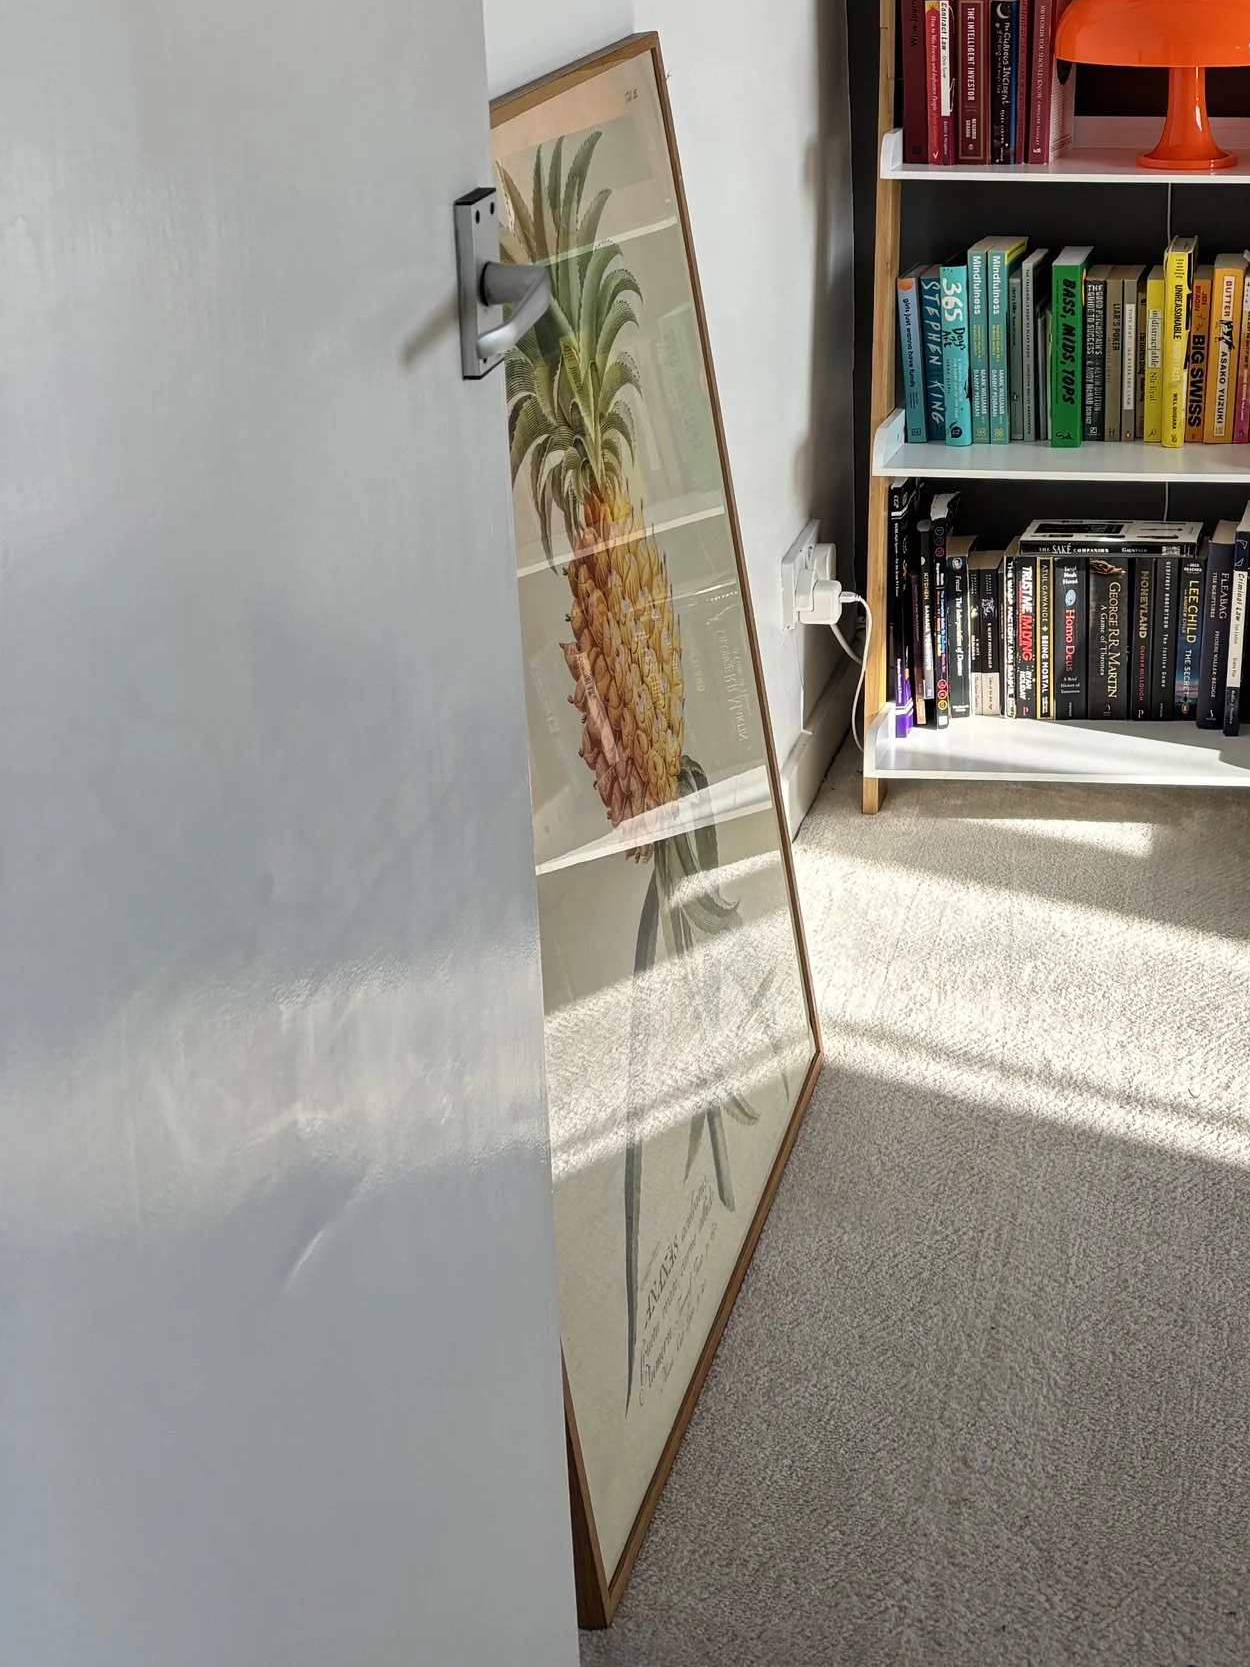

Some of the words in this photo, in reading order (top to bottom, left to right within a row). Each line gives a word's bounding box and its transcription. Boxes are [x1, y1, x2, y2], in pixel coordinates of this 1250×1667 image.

[967, 7, 975, 21] THE
[1038, 15, 1046, 36] WORDS
[910, 24, 918, 47] Wine
[967, 21, 975, 65] INTELLIGENT
[1037, 52, 1045, 79] SHOULD
[967, 67, 975, 101] INVESTOR
[941, 277, 963, 322] 365
[972, 255, 982, 315] Mindfulness
[991, 255, 1001, 315] Mindfulness
[1060, 277, 1077, 319] BASS,
[1095, 291, 1104, 309] GOOD
[1224, 280, 1233, 317] BUTTER
[902, 297, 911, 313] girls
[1086, 291, 1095, 313] GUIDE
[1112, 303, 1121, 326] LIAR'S
[1172, 284, 1183, 340] UNREASONABLE
[903, 313, 912, 327] just
[920, 281, 942, 365] STEPHEN
[1086, 313, 1095, 323] TO
[1094, 310, 1104, 355] PSYCHOPATH'S
[941, 330, 952, 348] Art
[952, 326, 966, 351] Days
[1060, 323, 1077, 365] MIDS,
[1086, 324, 1095, 355] SUCCESS
[1112, 326, 1121, 351] POKER
[1190, 334, 1205, 365] BIG
[906, 351, 915, 367] have
[1219, 351, 1228, 384] ASAKO
[1061, 368, 1077, 405] TOPS
[1149, 371, 1157, 384] Nir
[927, 380, 945, 424] KING
[1147, 385, 1157, 401] Eyal
[1187, 367, 1204, 428] SWISS
[1217, 388, 1226, 424] YUZUKI
[1051, 542, 1072, 555] SAKÉ
[923, 572, 931, 600] KITCHEN
[954, 575, 963, 592] Freud
[1006, 578, 1014, 605] WASP
[1021, 565, 1034, 592] TRUST
[1188, 580, 1200, 603] LEE
[1210, 571, 1218, 583] THE
[1236, 573, 1246, 606] Criminal
[955, 597, 964, 607] The
[1108, 581, 1121, 626] GEORGE
[1138, 570, 1150, 639] MONEYLAND
[1209, 584, 1217, 618] SCRIPTURES
[1218, 572, 1230, 620] FLEABAG
[955, 608, 963, 646] Interpretation
[1064, 608, 1076, 643] Homo
[1099, 612, 1107, 632] Game
[1185, 604, 1199, 644] CHILD
[1235, 607, 1243, 622] Law
[924, 633, 933, 671] YOSHIMOTO
[1021, 629, 1034, 661] LYING
[1041, 635, 1049, 659] BEING
[1099, 635, 1107, 643] of
[1212, 630, 1220, 652] PHOEBE
[955, 654, 964, 677] Dreams
[1064, 644, 1076, 672] Deus
[1099, 646, 1107, 676] Thrones
[1183, 649, 1192, 665] THE
[1006, 664, 1014, 695] BANKS
[1041, 662, 1049, 693] MORTAL
[1107, 651, 1120, 698] MARTIN
[1138, 667, 1146, 701] BULLOUGH
[1182, 666, 1191, 696] SECRET
[1210, 653, 1219, 698] WALLER-BRIDGE
